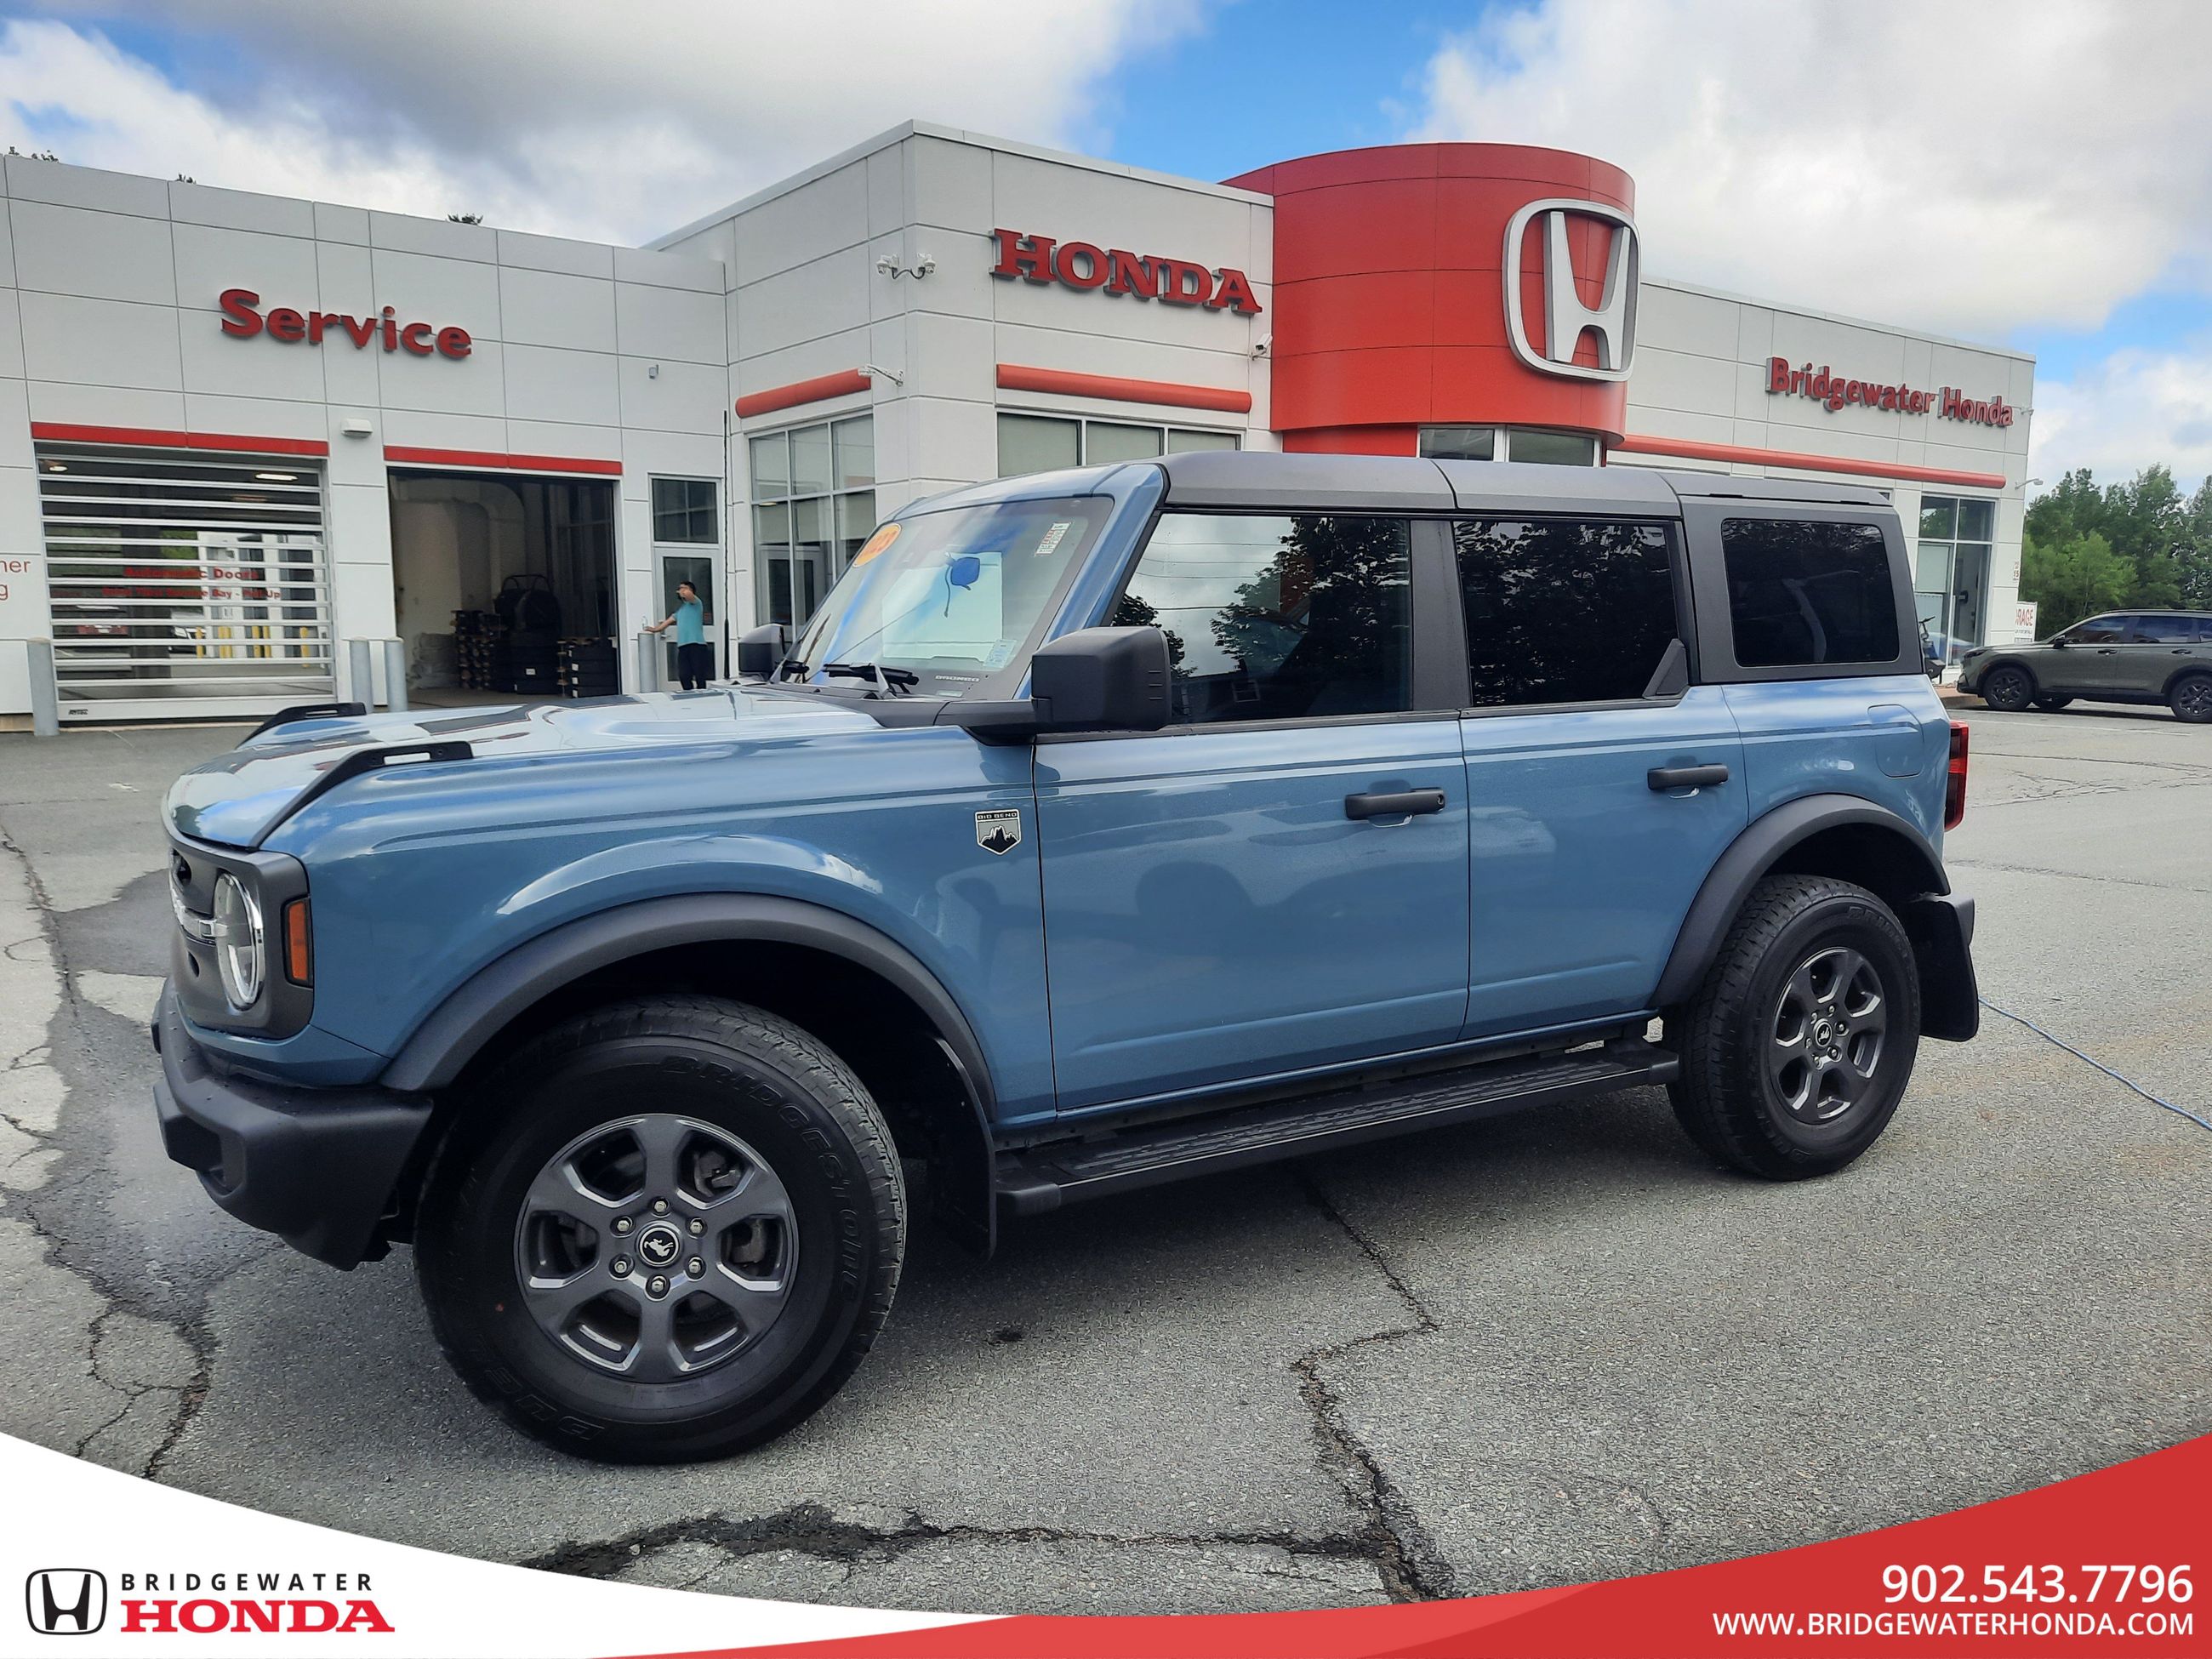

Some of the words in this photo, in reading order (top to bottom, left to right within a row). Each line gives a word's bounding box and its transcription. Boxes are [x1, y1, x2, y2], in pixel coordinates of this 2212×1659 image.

[992, 228, 1263, 315] HONDA
[219, 288, 472, 358] Service
[1769, 356, 1936, 412] Bridgewater
[1942, 386, 2013, 425] Honda
